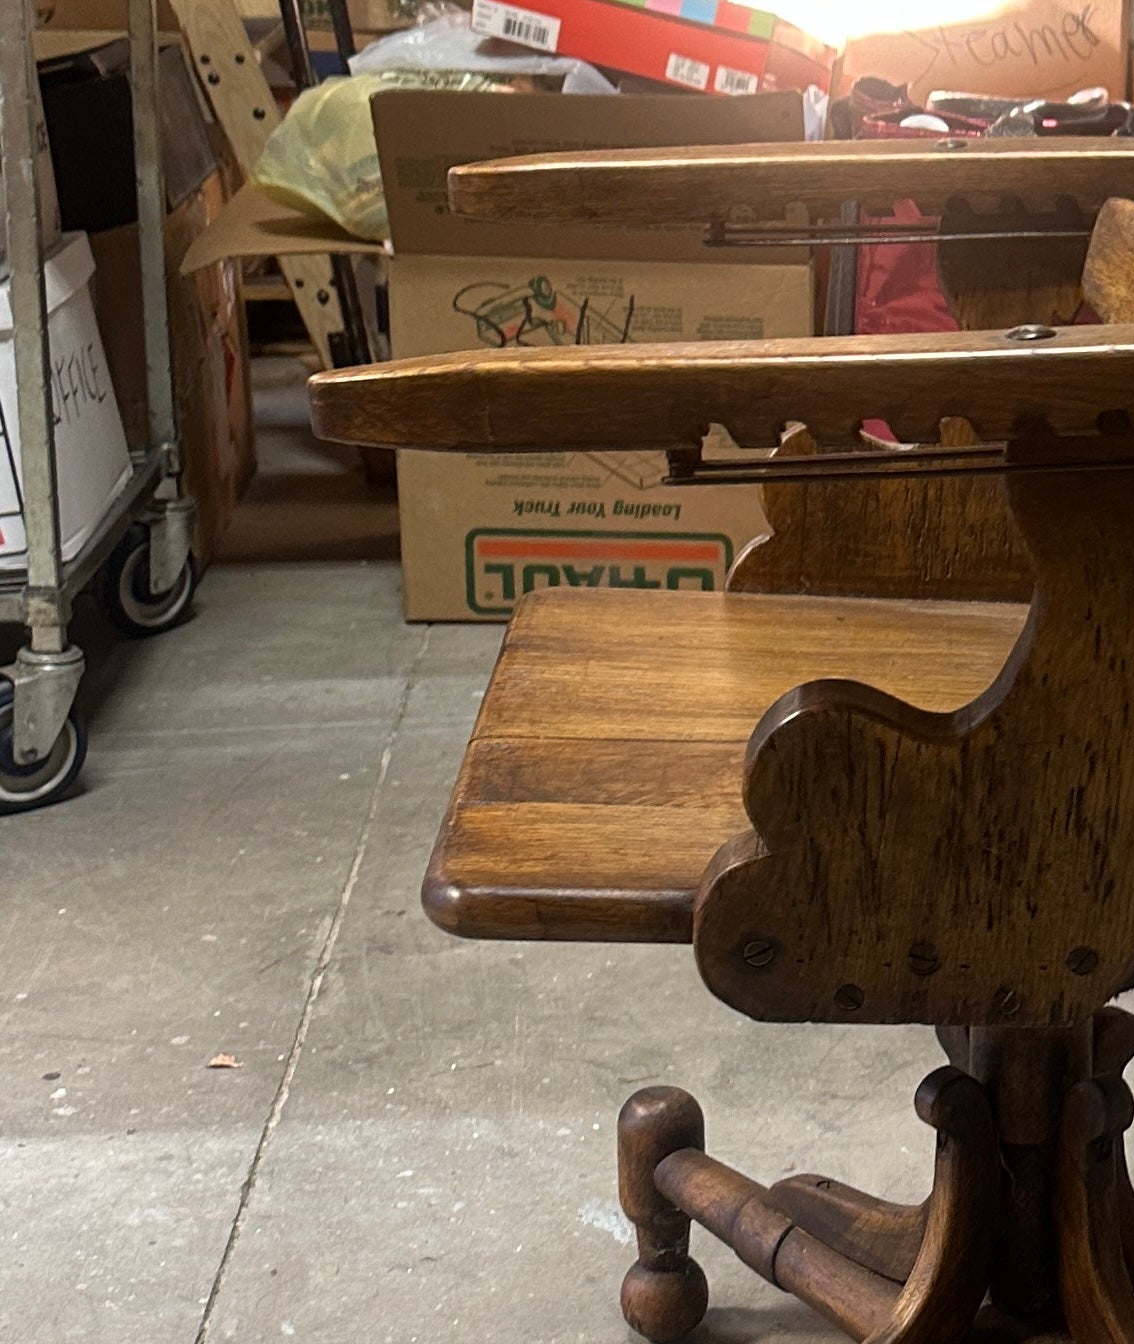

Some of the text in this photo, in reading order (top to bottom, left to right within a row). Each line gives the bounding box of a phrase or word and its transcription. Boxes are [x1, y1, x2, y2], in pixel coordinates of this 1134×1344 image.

[513, 497, 682, 521] Loading Your Truck
